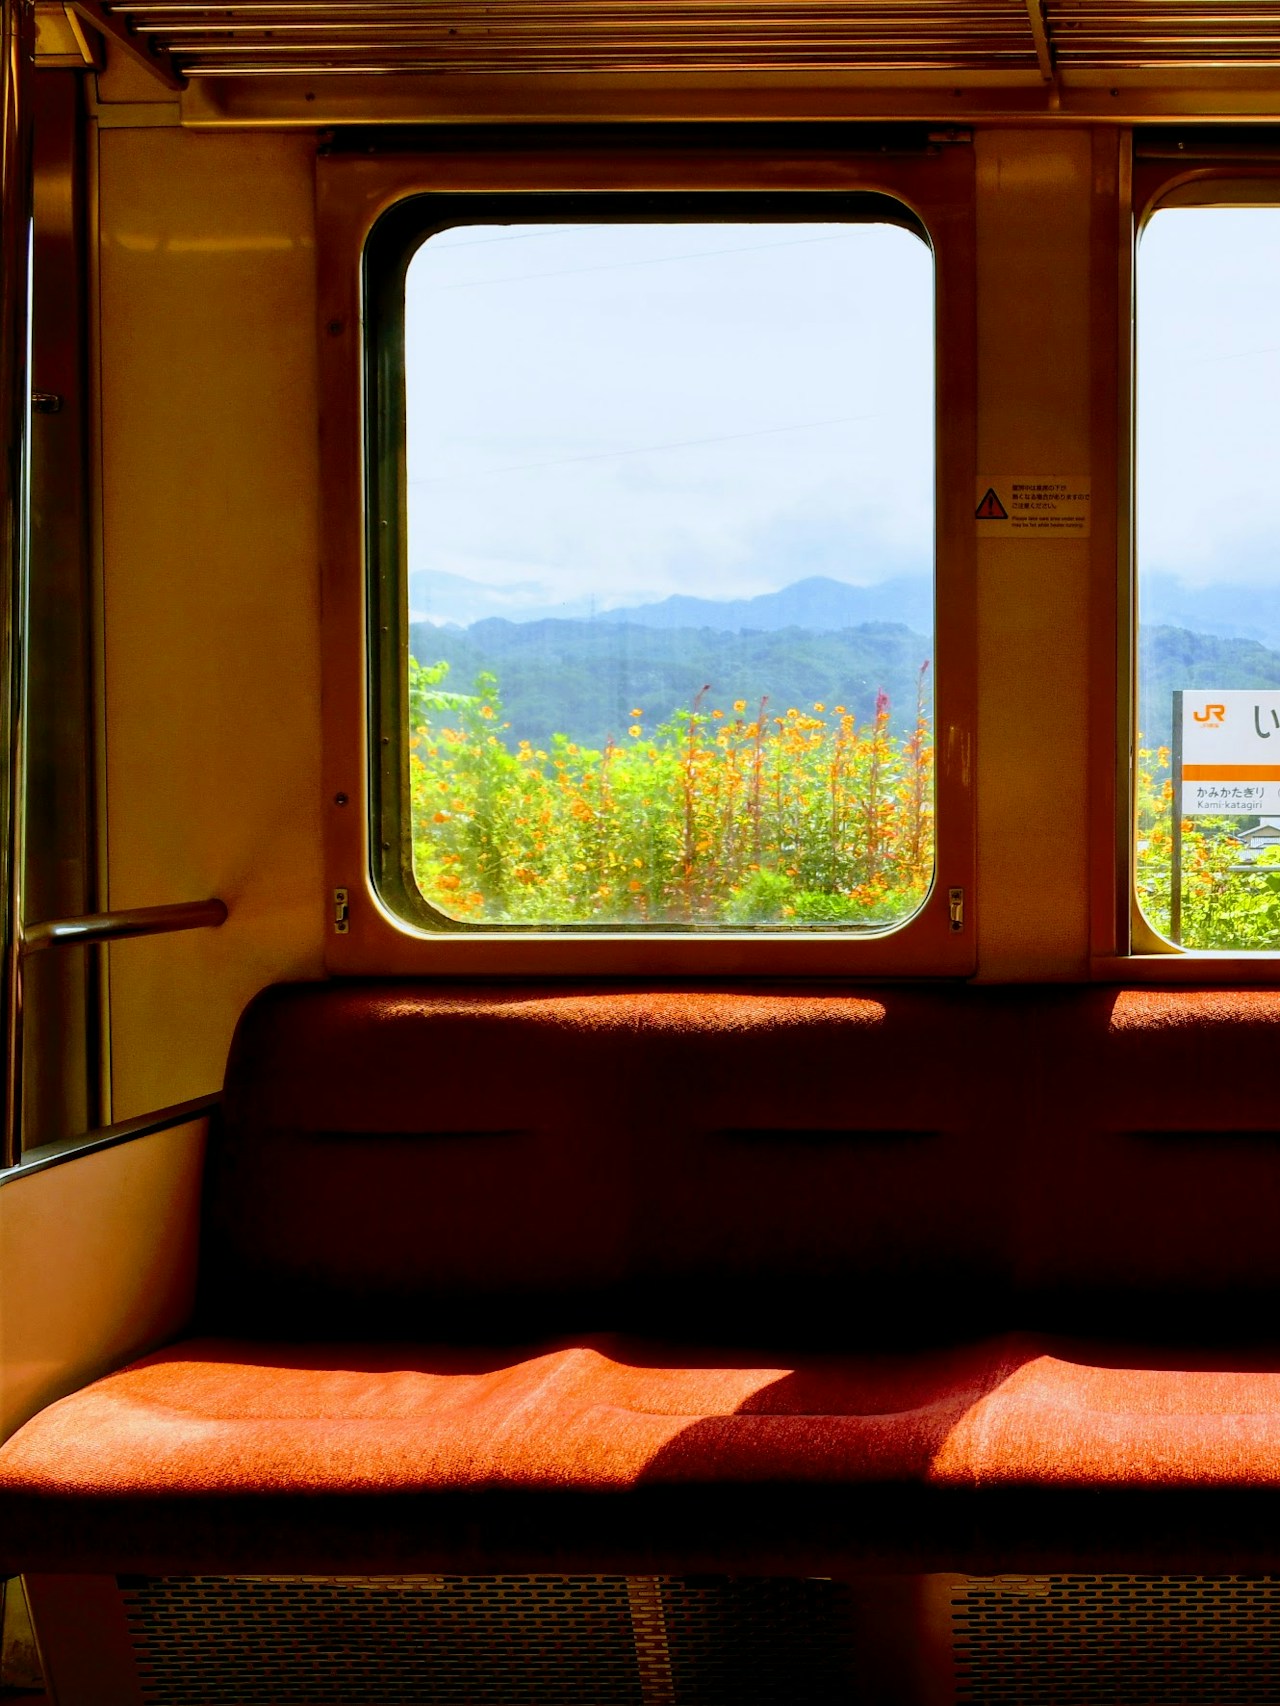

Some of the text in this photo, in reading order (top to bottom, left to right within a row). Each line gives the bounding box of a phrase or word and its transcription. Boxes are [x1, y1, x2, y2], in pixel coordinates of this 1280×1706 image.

[1193, 704, 1226, 722] JR
[1196, 787, 1265, 798] かみかたぎり
[1197, 800, 1263, 811] Kami-katagiri
